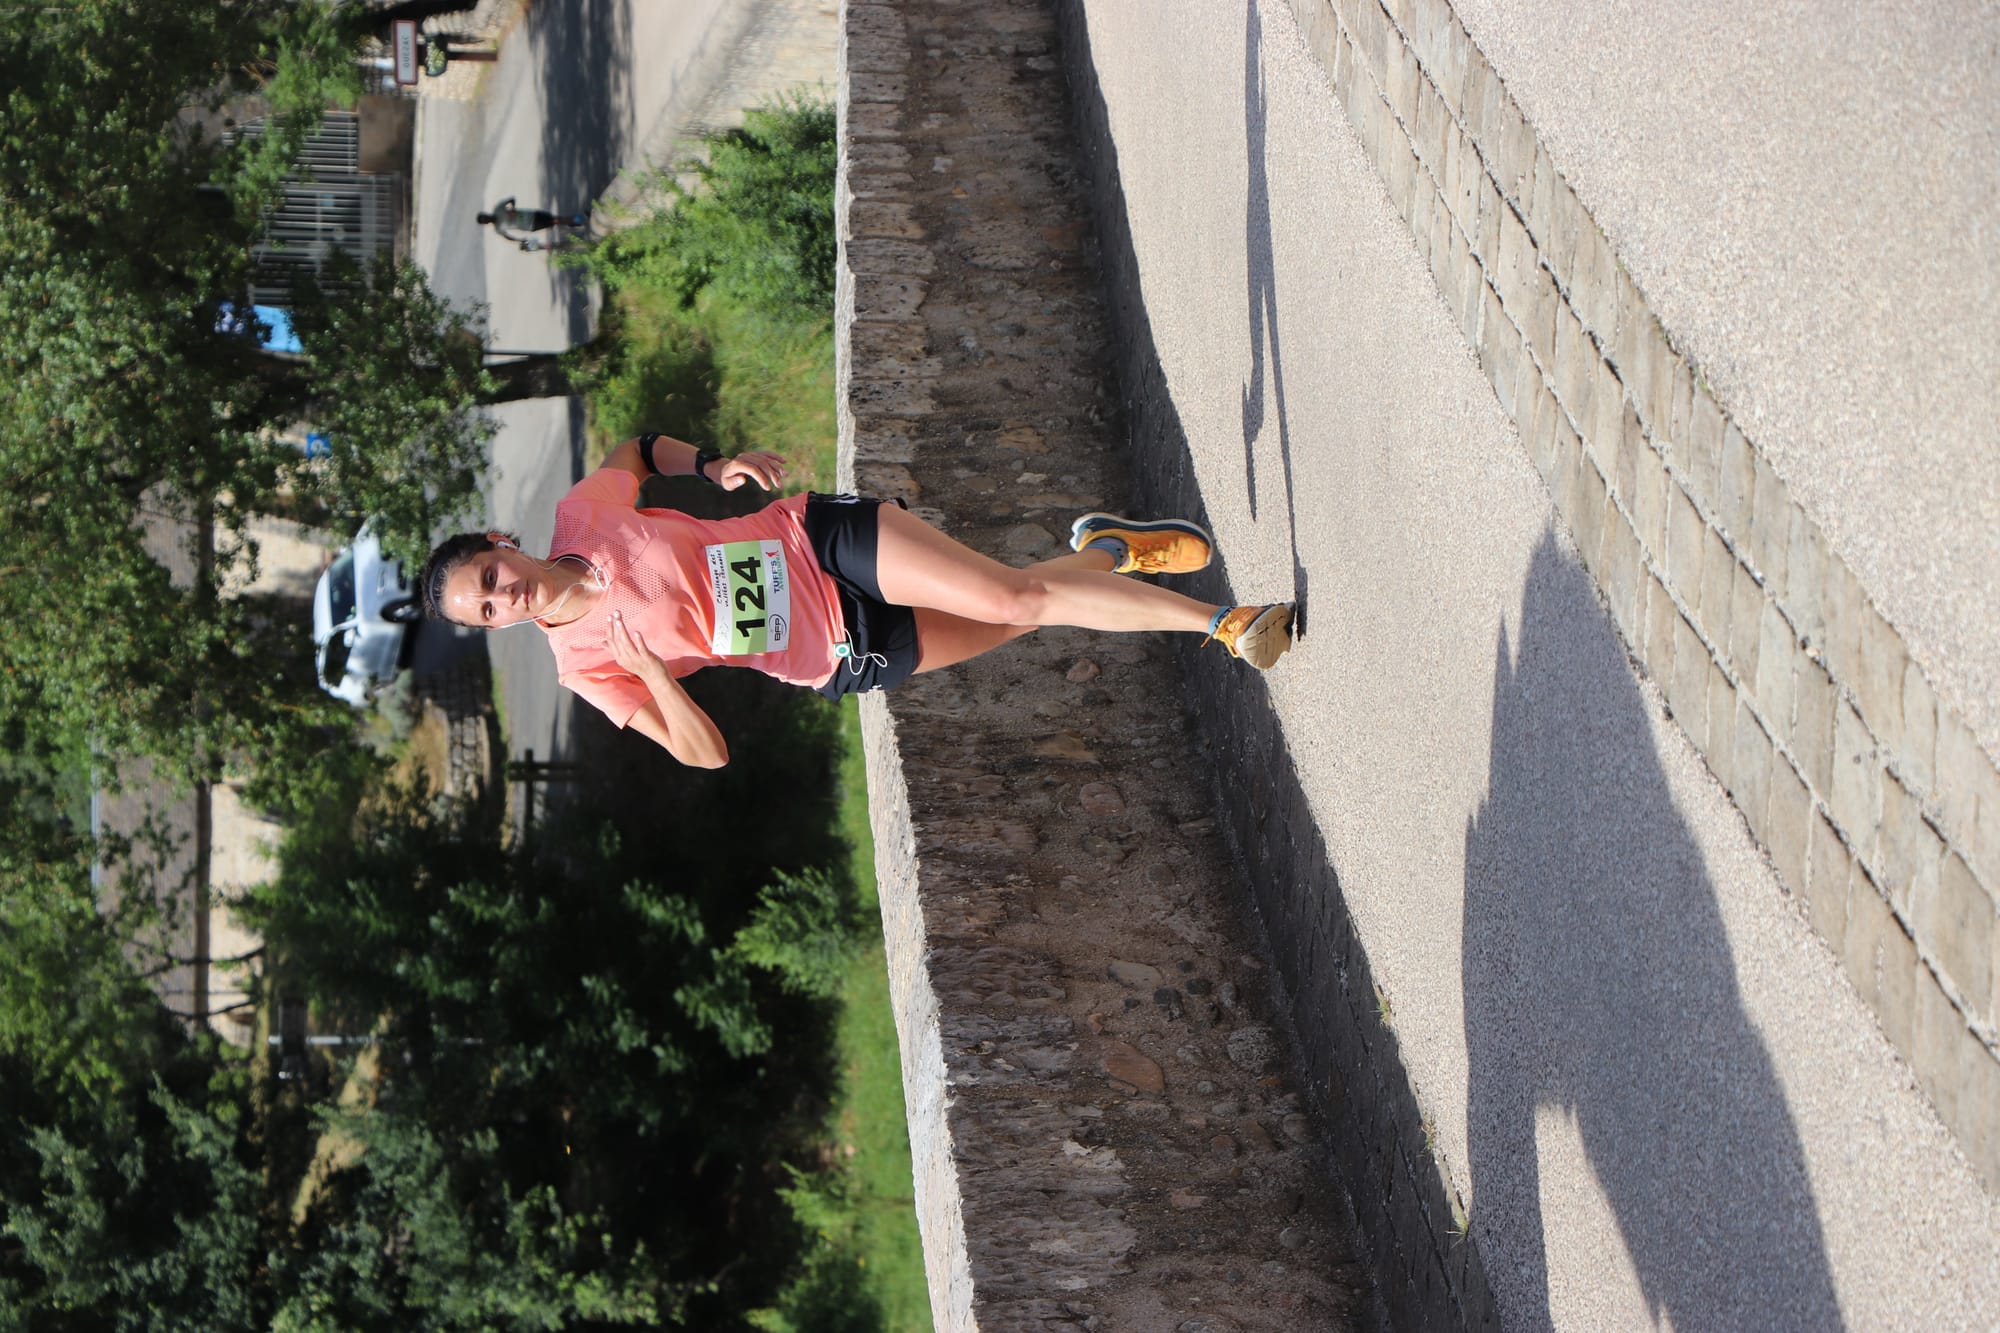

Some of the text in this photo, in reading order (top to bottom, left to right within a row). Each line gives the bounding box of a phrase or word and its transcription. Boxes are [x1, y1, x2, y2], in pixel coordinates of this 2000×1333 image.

[714, 569, 722, 604] Challenge
[770, 560, 780, 594] TUFF'S
[731, 556, 765, 638] 124
